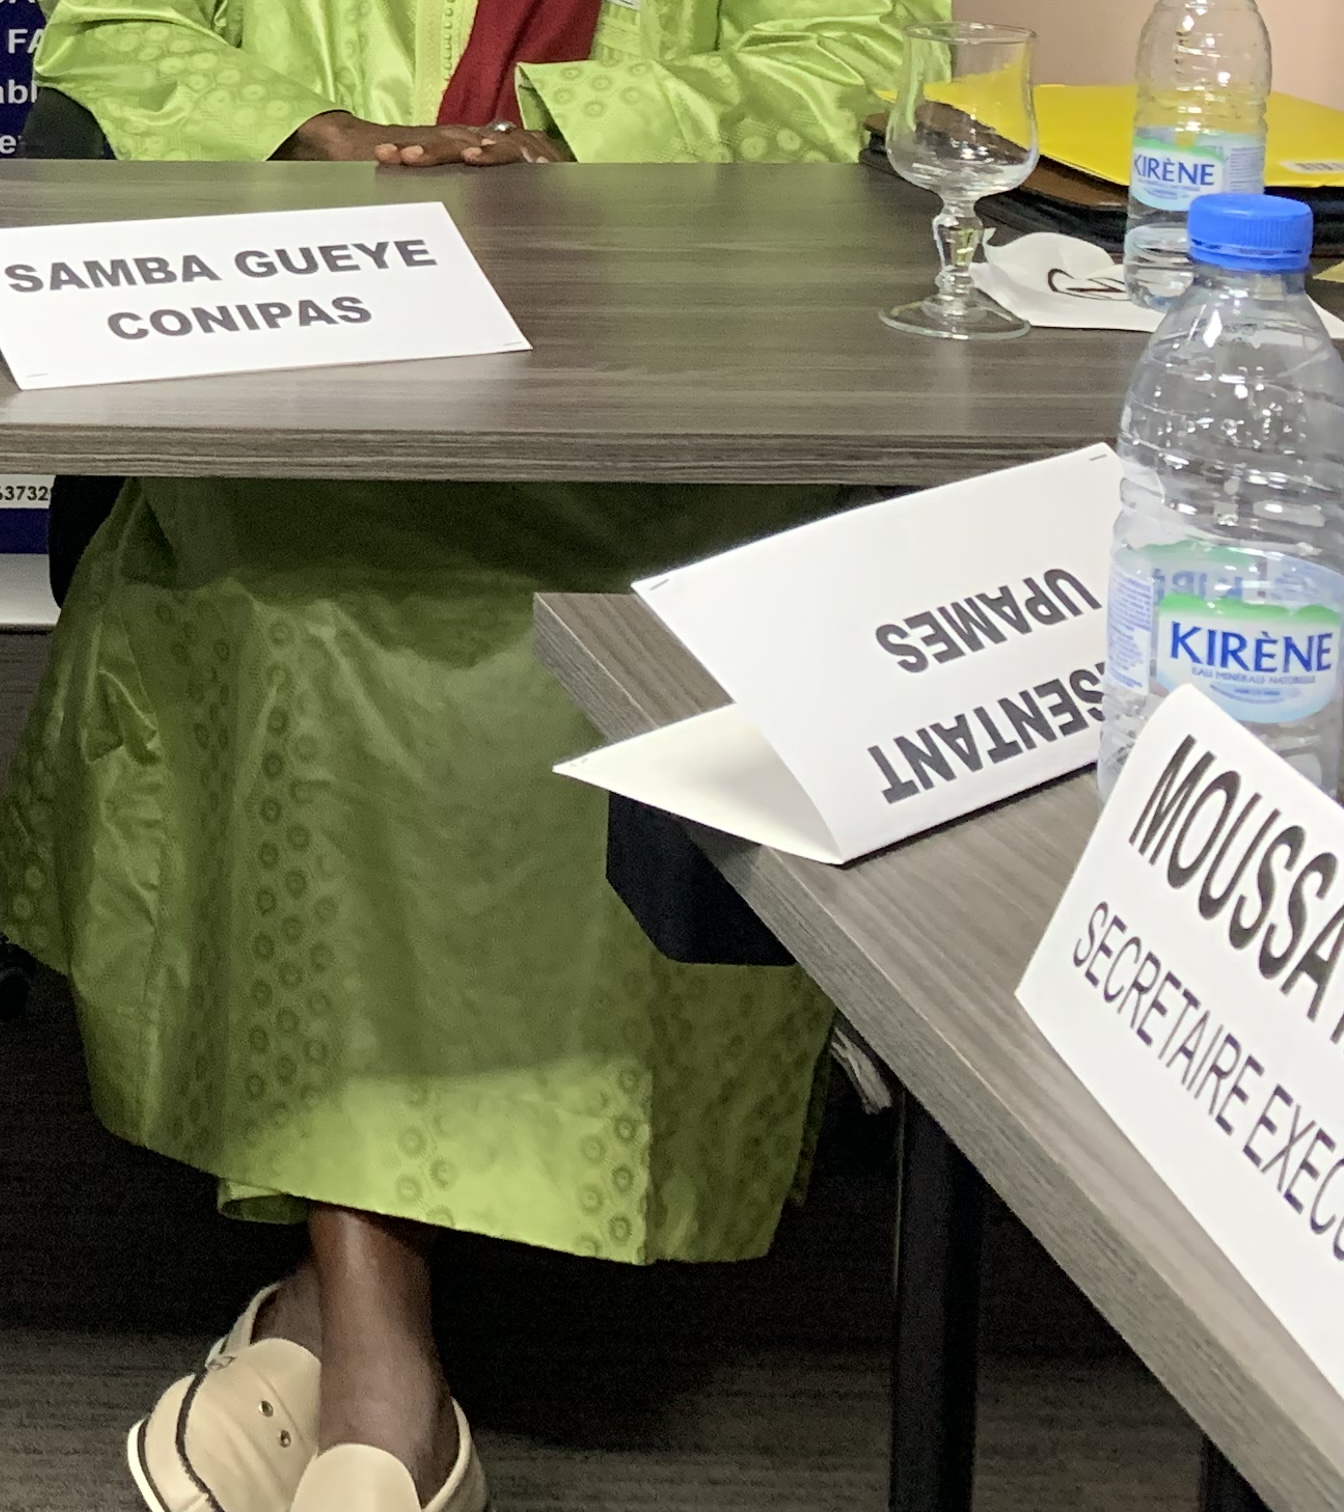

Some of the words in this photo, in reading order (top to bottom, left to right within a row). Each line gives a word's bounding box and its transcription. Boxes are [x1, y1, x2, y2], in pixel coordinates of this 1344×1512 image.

[1134, 154, 1216, 186] KIRÈNE
[5, 255, 221, 292] SAMBA
[235, 239, 436, 278] GUEYE
[106, 296, 373, 341] CONIPAS
[875, 568, 1103, 673] UPAMES
[1170, 620, 1334, 673] KIRÈNE
[867, 661, 1106, 805] SENTANT
[1129, 734, 1344, 1023] MOUSSA
[1073, 899, 1265, 1137] SECRETAIRE
